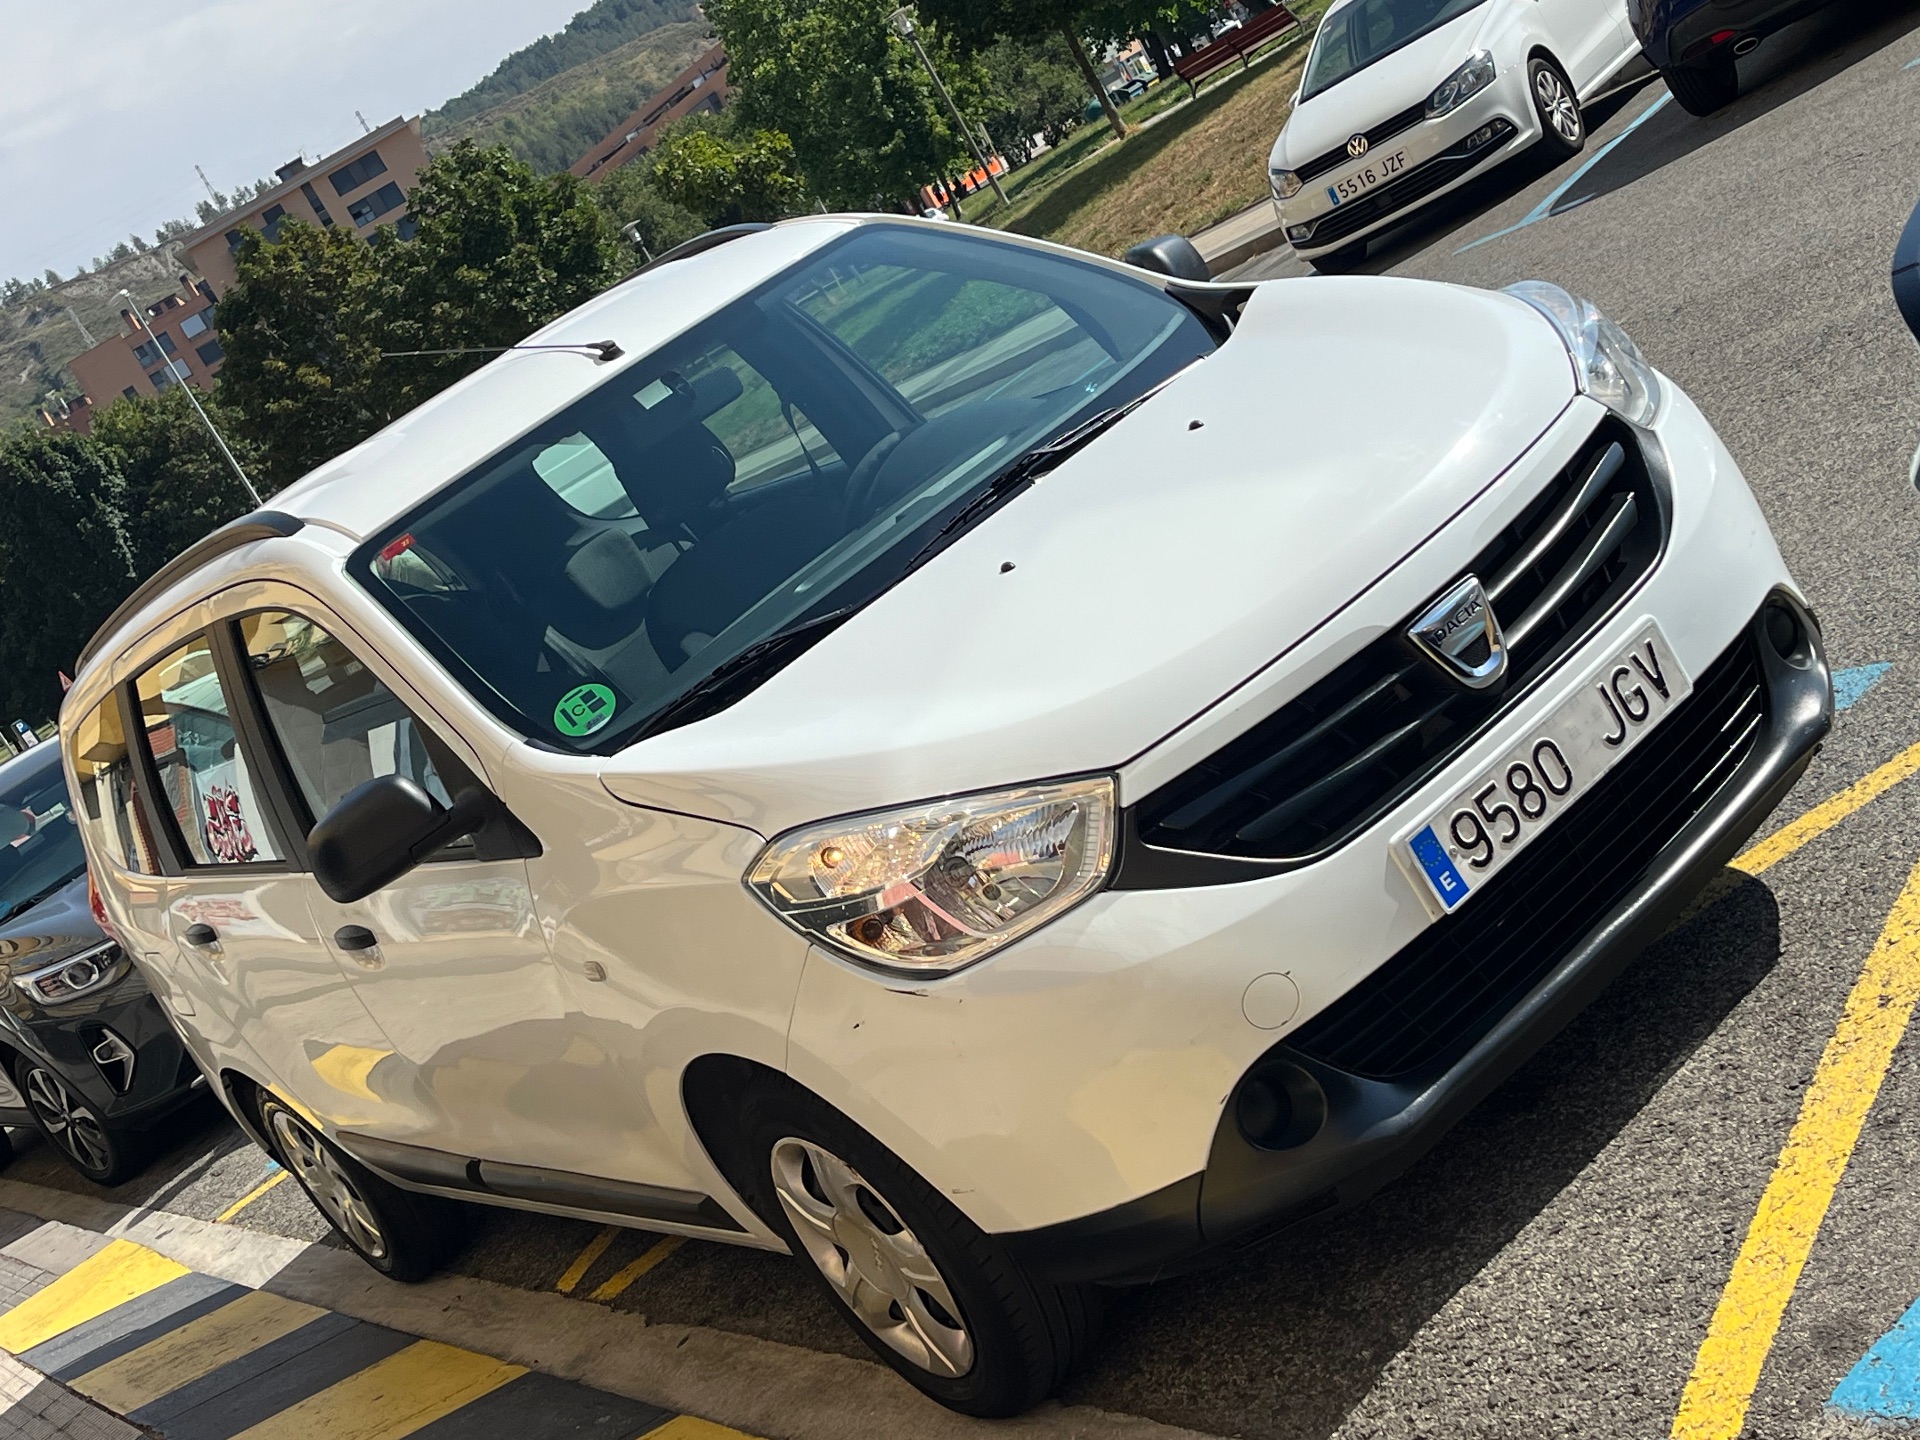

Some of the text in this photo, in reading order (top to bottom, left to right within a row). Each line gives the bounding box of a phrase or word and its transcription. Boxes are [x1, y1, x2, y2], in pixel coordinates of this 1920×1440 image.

[1347, 135, 1368, 157] VW
[1337, 151, 1405, 198] 5516 JZF
[1433, 600, 1483, 648] DACIA
[15, 722, 24, 733] P
[571, 704, 586, 717] C
[1439, 638, 1672, 892] E 9580 JGV
